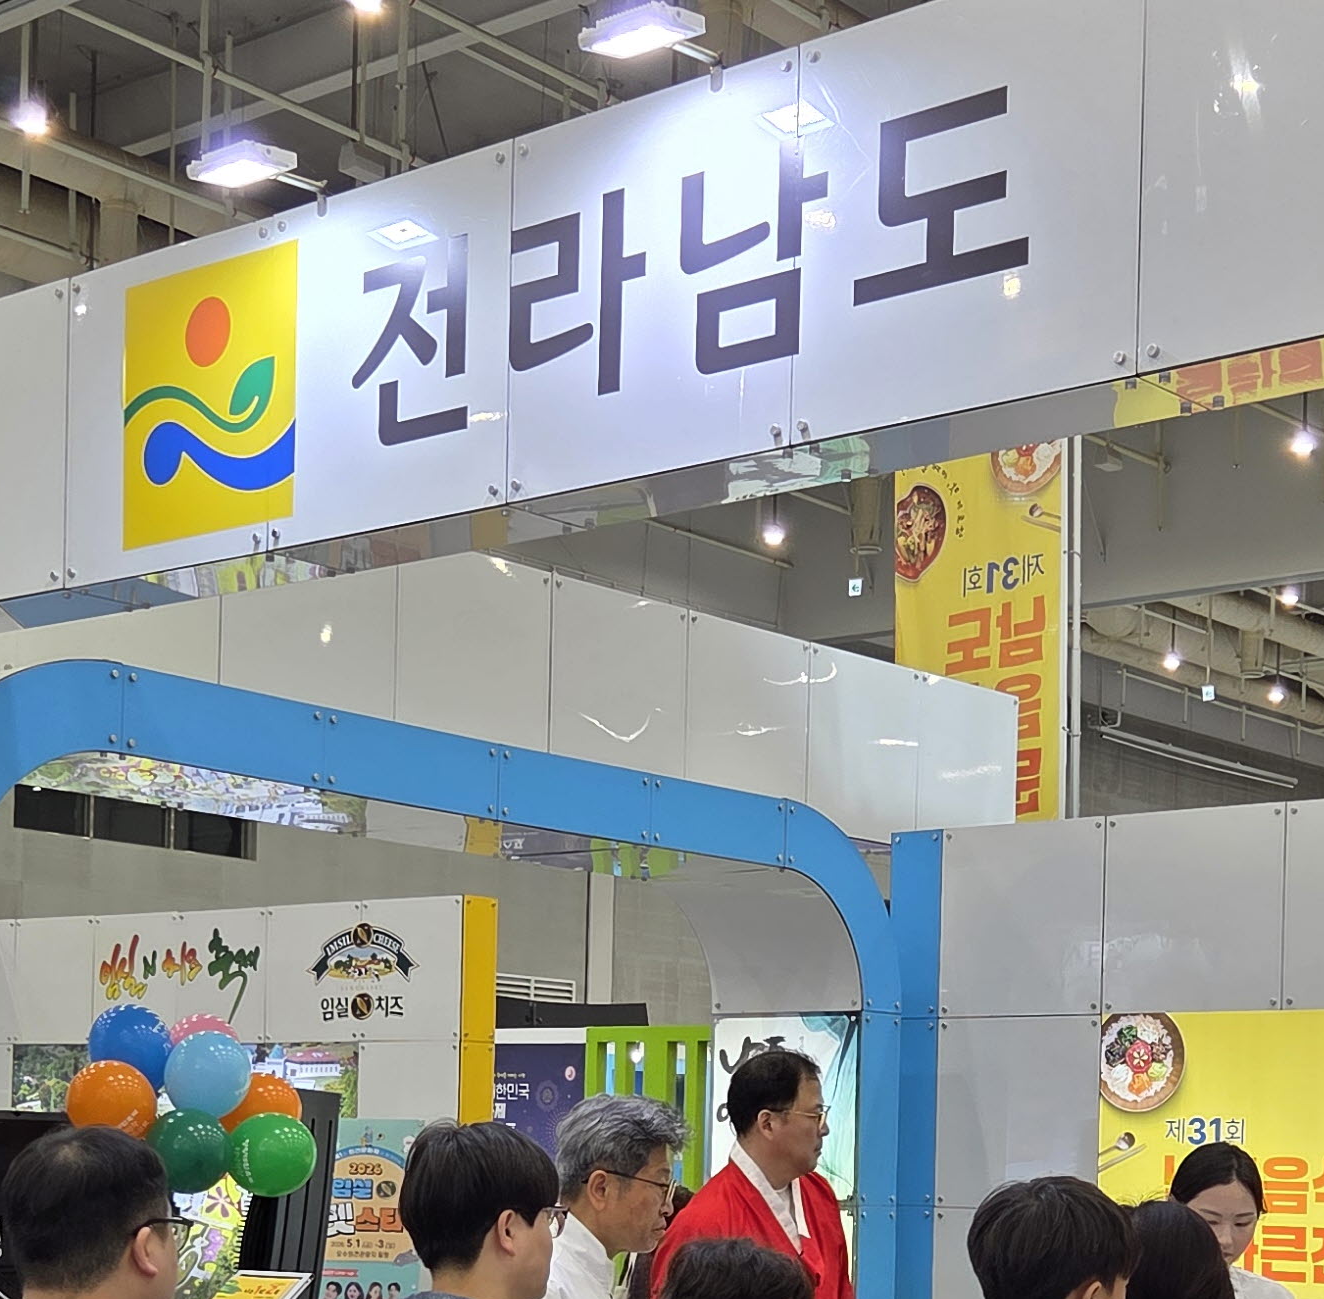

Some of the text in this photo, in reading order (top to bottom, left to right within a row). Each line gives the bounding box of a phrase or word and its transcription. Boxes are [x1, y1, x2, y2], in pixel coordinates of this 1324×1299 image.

[352, 84, 1030, 447] 전라남도
[325, 934, 400, 956] IMSIL CHEESE
[494, 1083, 530, 1101] 한민국
[1165, 1117, 1246, 1145] 제31회
[349, 1162, 383, 1176] 2026
[332, 1178, 374, 1199] 임실
